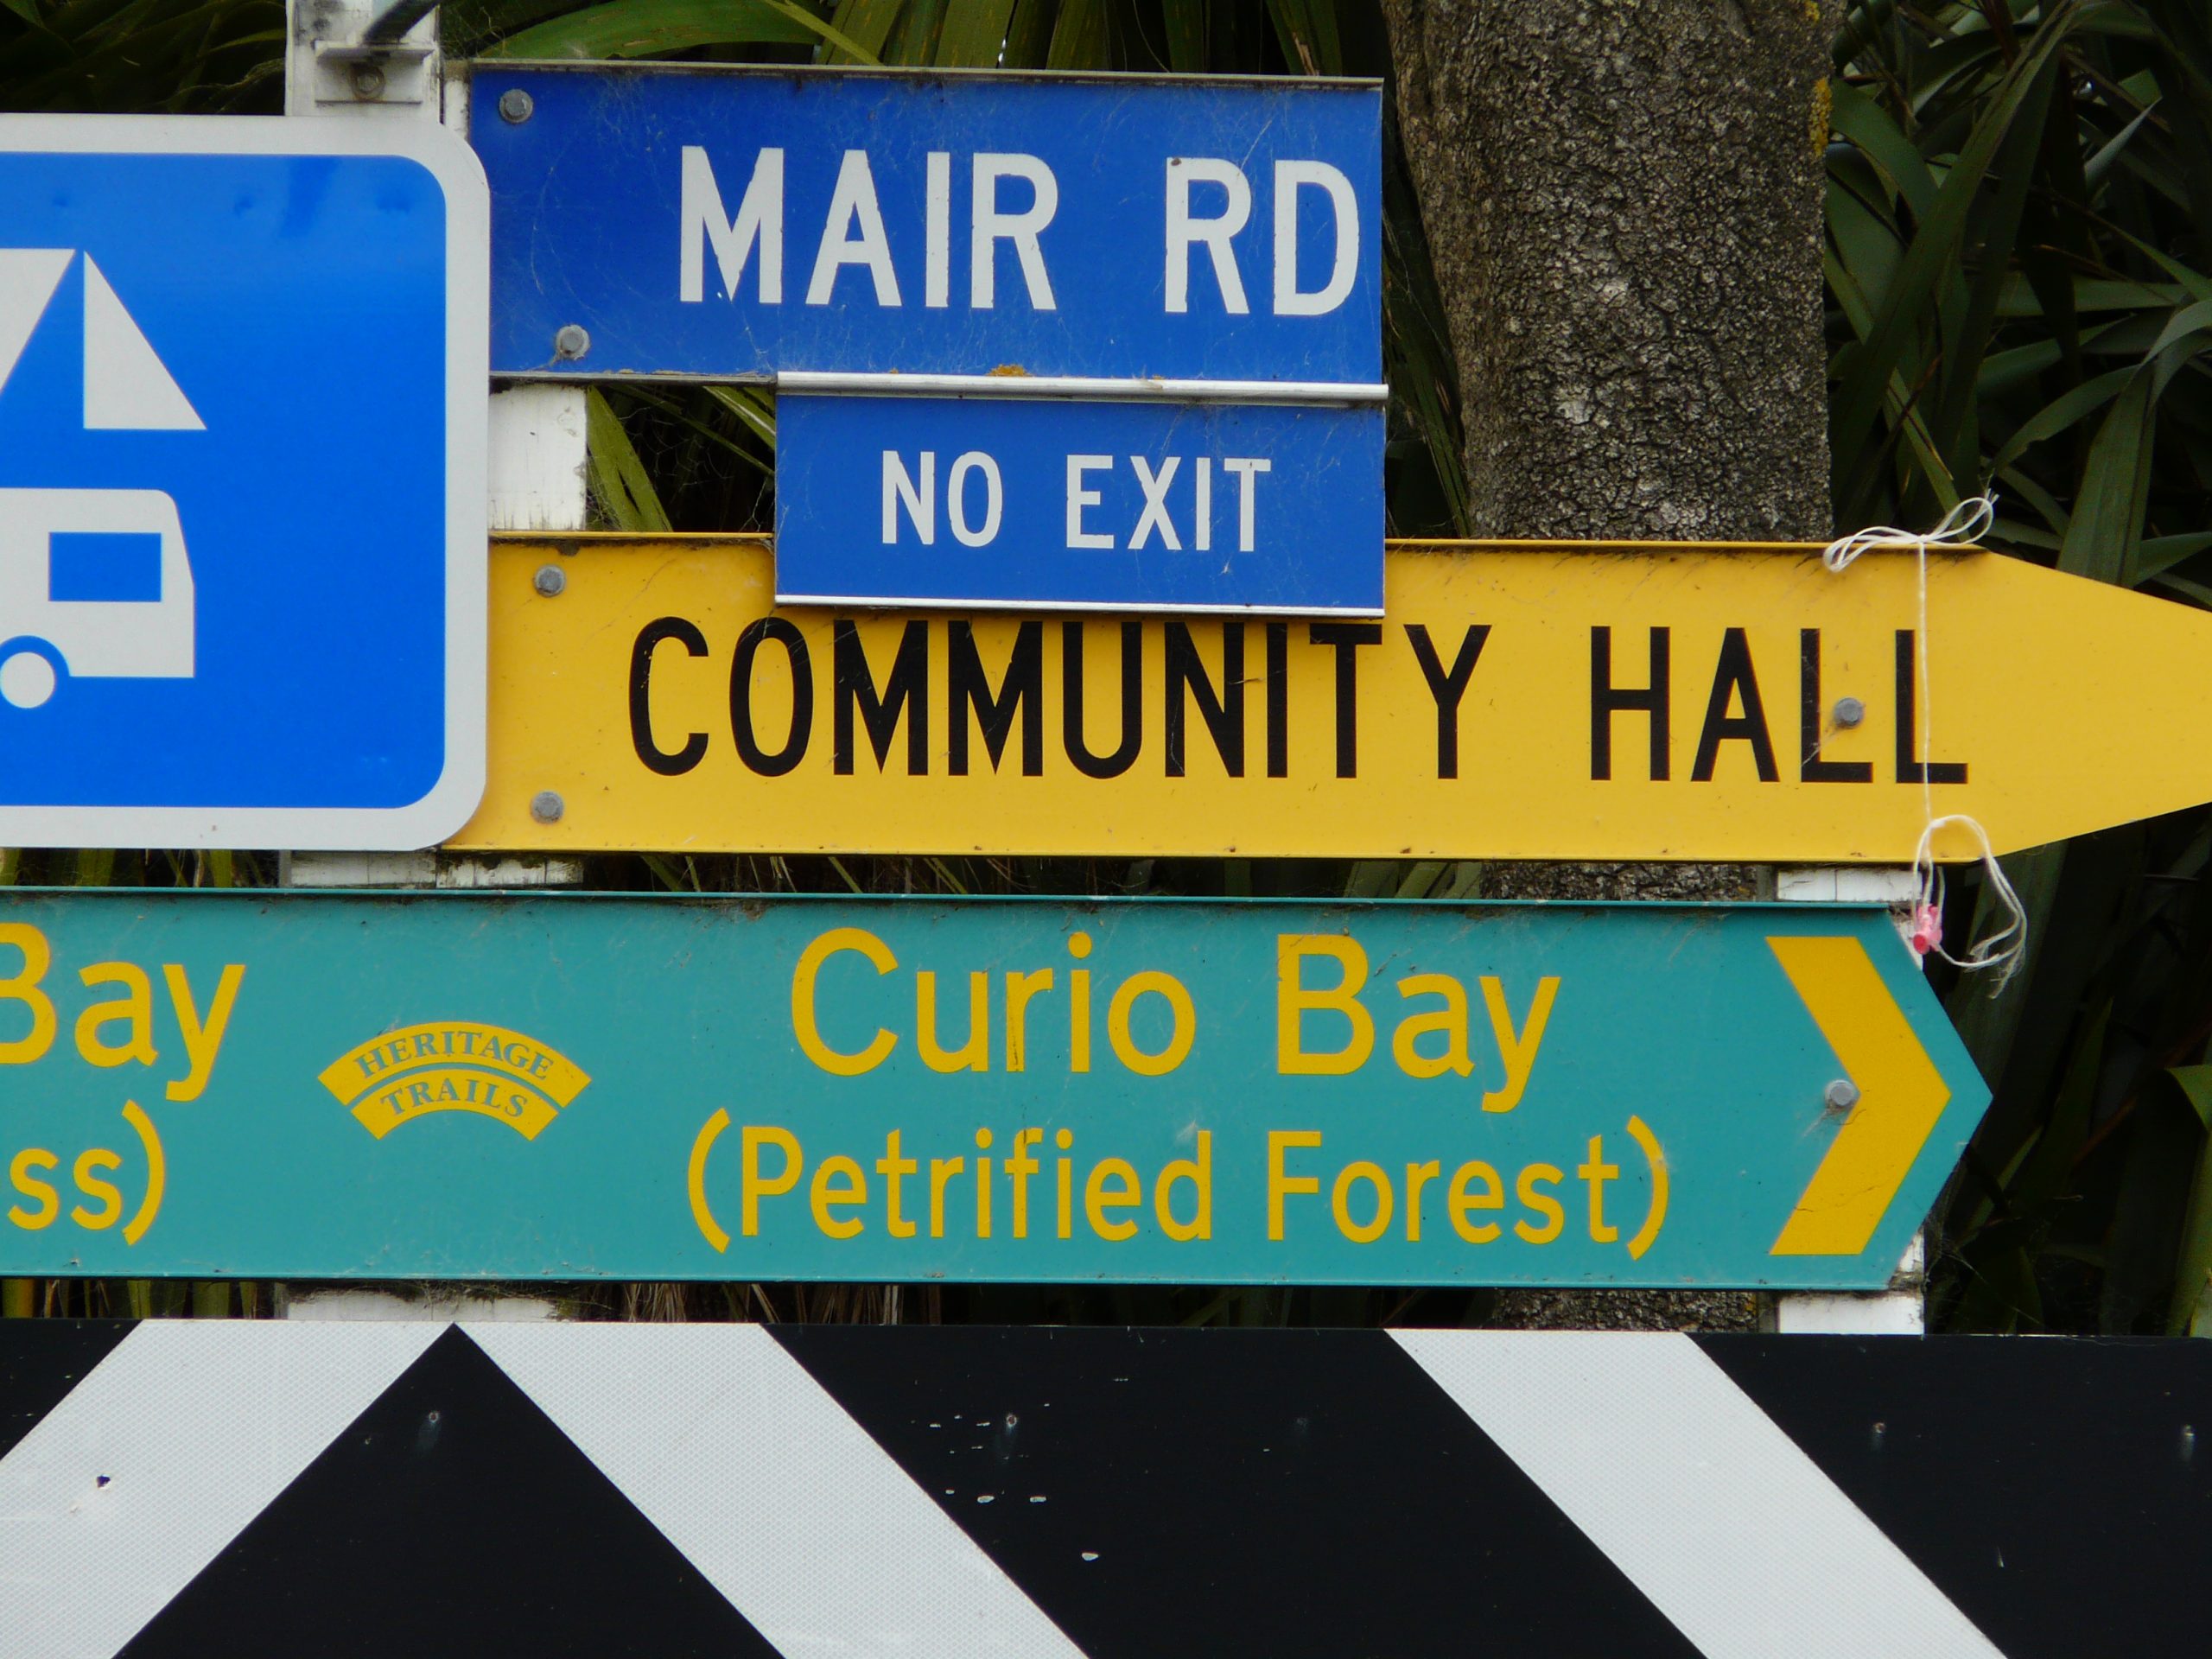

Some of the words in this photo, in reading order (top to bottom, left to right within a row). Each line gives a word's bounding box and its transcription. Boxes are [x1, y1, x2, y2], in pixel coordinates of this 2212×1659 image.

[679, 145, 1059, 311] MAIR
[1165, 158, 1361, 316] RD
[880, 450, 1004, 548] NO
[1065, 455, 1273, 553] EXIT
[630, 617, 1490, 779] COMMUNITY
[1593, 628, 1967, 782] HALL
[353, 1031, 554, 1080] HERITAGE
[791, 927, 1196, 1077] Curio
[1277, 934, 1560, 1113] Bay
[380, 1077, 528, 1117] TRAILS
[8, 1099, 166, 1245] ss)
[687, 1108, 1211, 1253] (Petrified
[1266, 1116, 1669, 1259] Forest)
